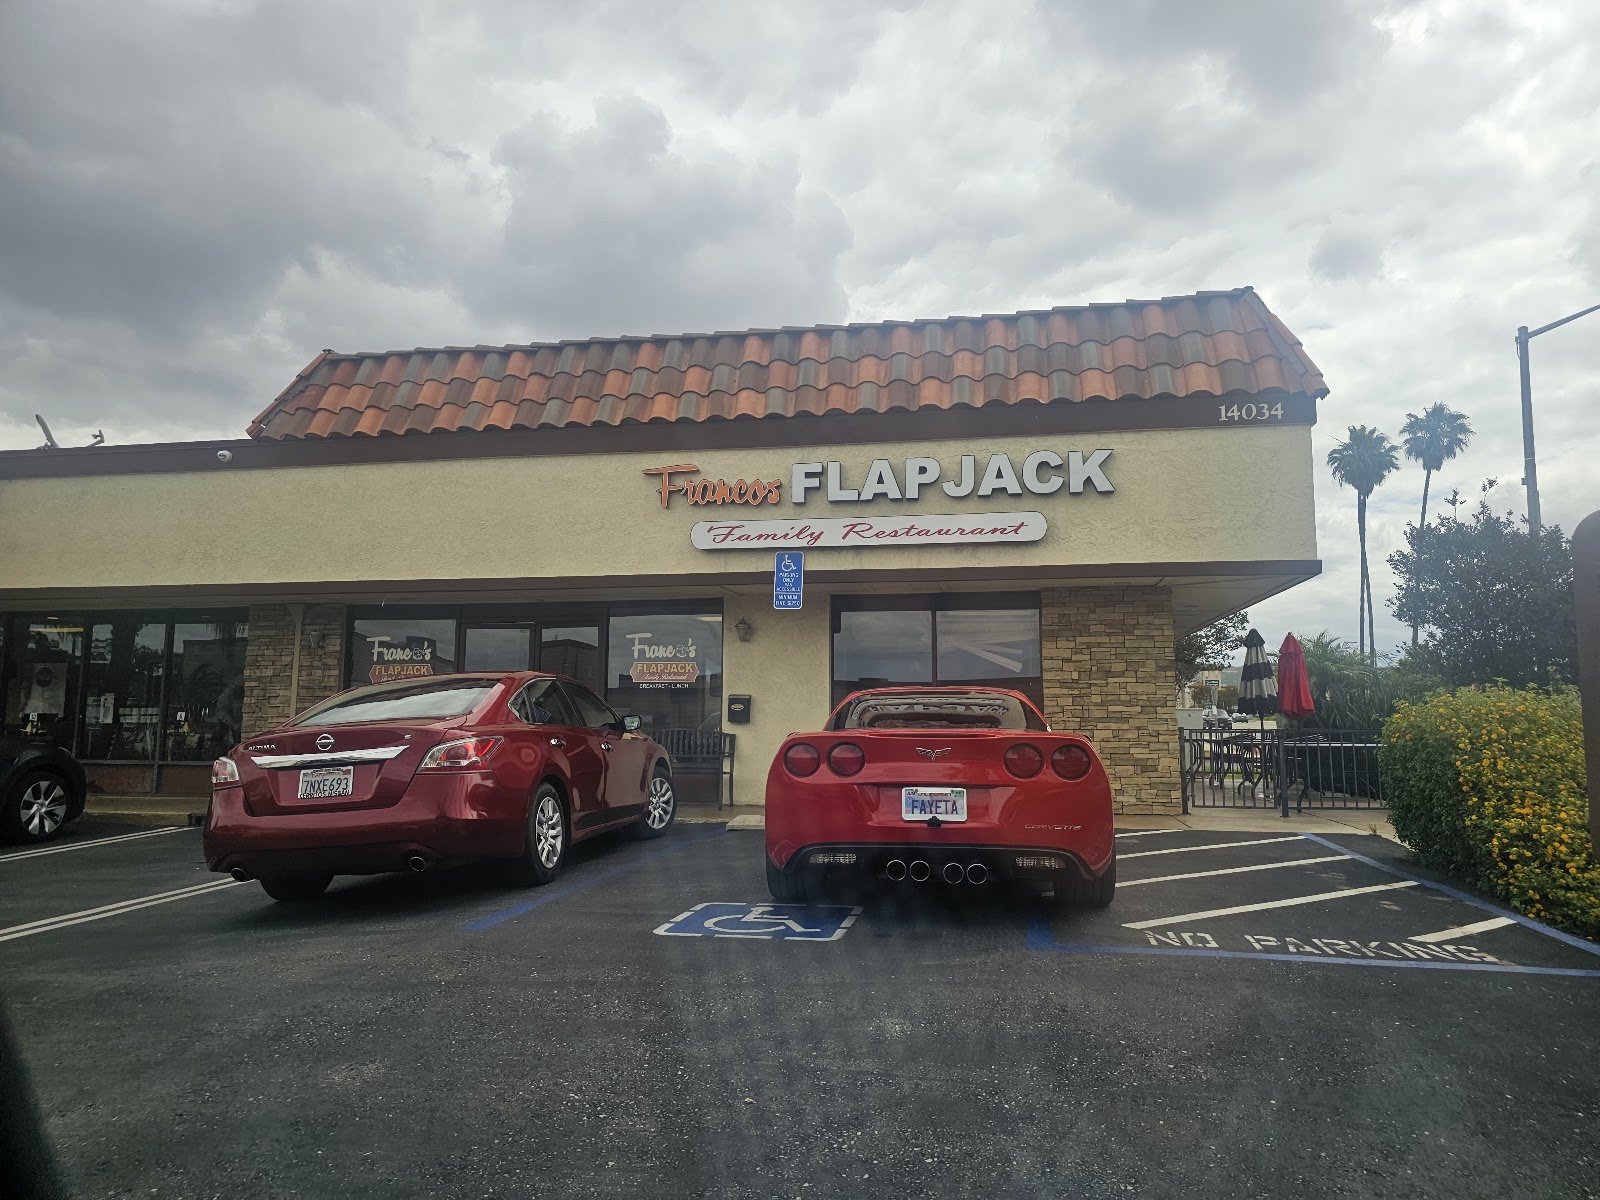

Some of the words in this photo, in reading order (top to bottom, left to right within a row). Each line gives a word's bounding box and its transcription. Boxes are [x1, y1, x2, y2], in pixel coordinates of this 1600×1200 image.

[1219, 402, 1284, 421] 14034
[641, 464, 782, 508] Francos
[791, 448, 1116, 505] FLAPJACK
[707, 525, 825, 546] Family
[841, 521, 1029, 540] Restaurant
[375, 665, 429, 675] FLAPJACK
[637, 663, 694, 673] FLAPJACK
[303, 777, 350, 794] 7NXE693
[911, 799, 959, 815] FAYETA
[1146, 931, 1219, 948] NO
[1244, 934, 1503, 964] PARKING
